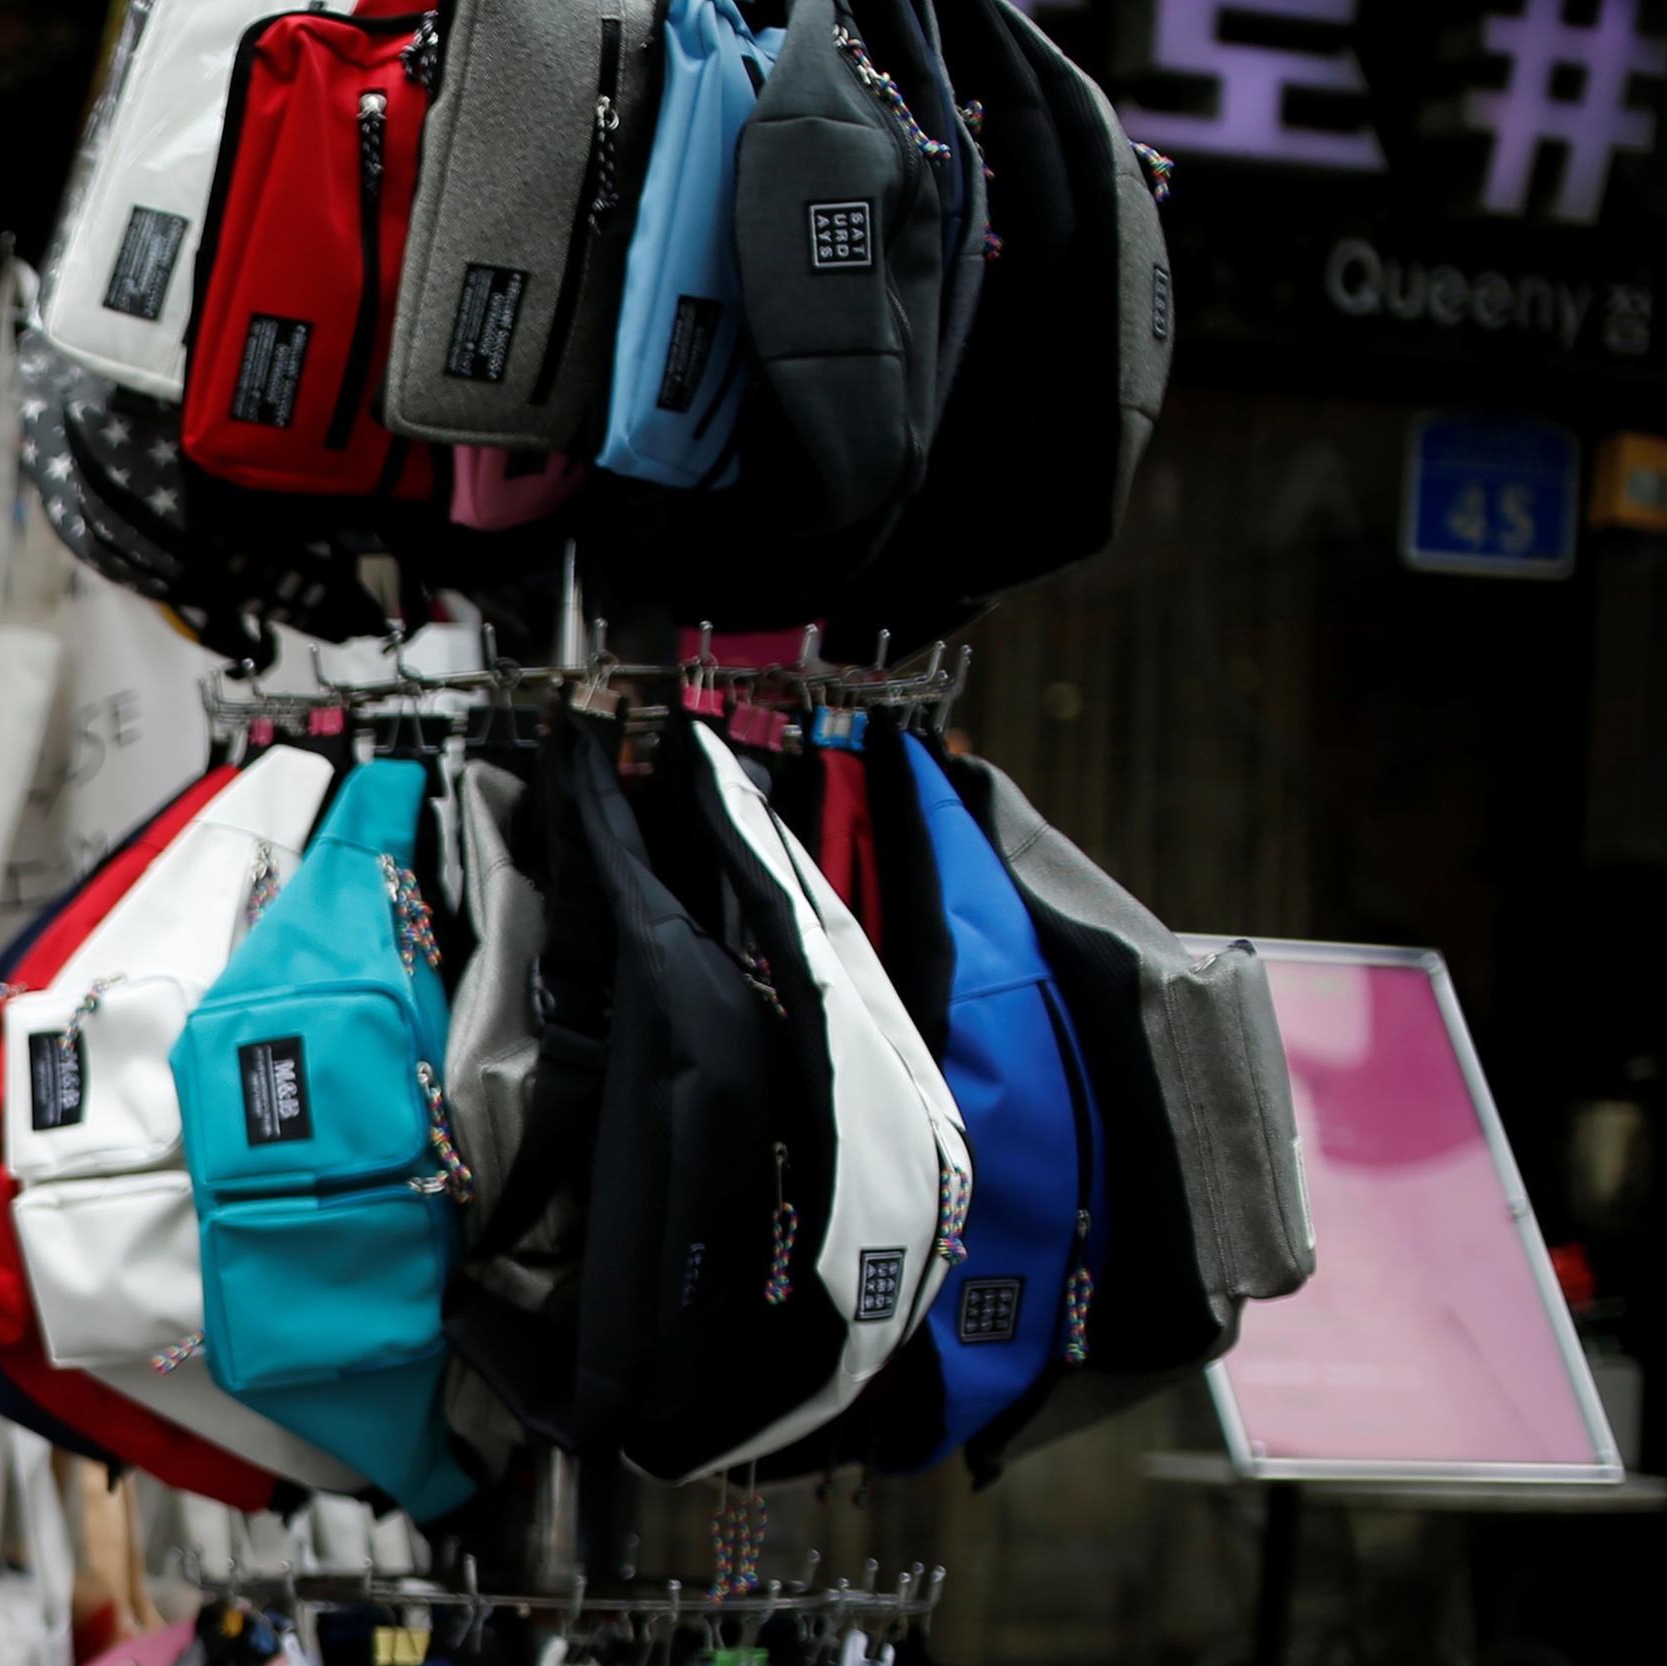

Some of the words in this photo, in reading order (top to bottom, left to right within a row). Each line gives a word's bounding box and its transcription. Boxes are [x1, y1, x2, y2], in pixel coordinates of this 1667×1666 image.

[816, 214, 834, 259] AYS
[832, 213, 849, 258] URD
[850, 211, 865, 256] SAT
[1324, 236, 1594, 350] Queeny
[273, 1058, 300, 1121] M&B
